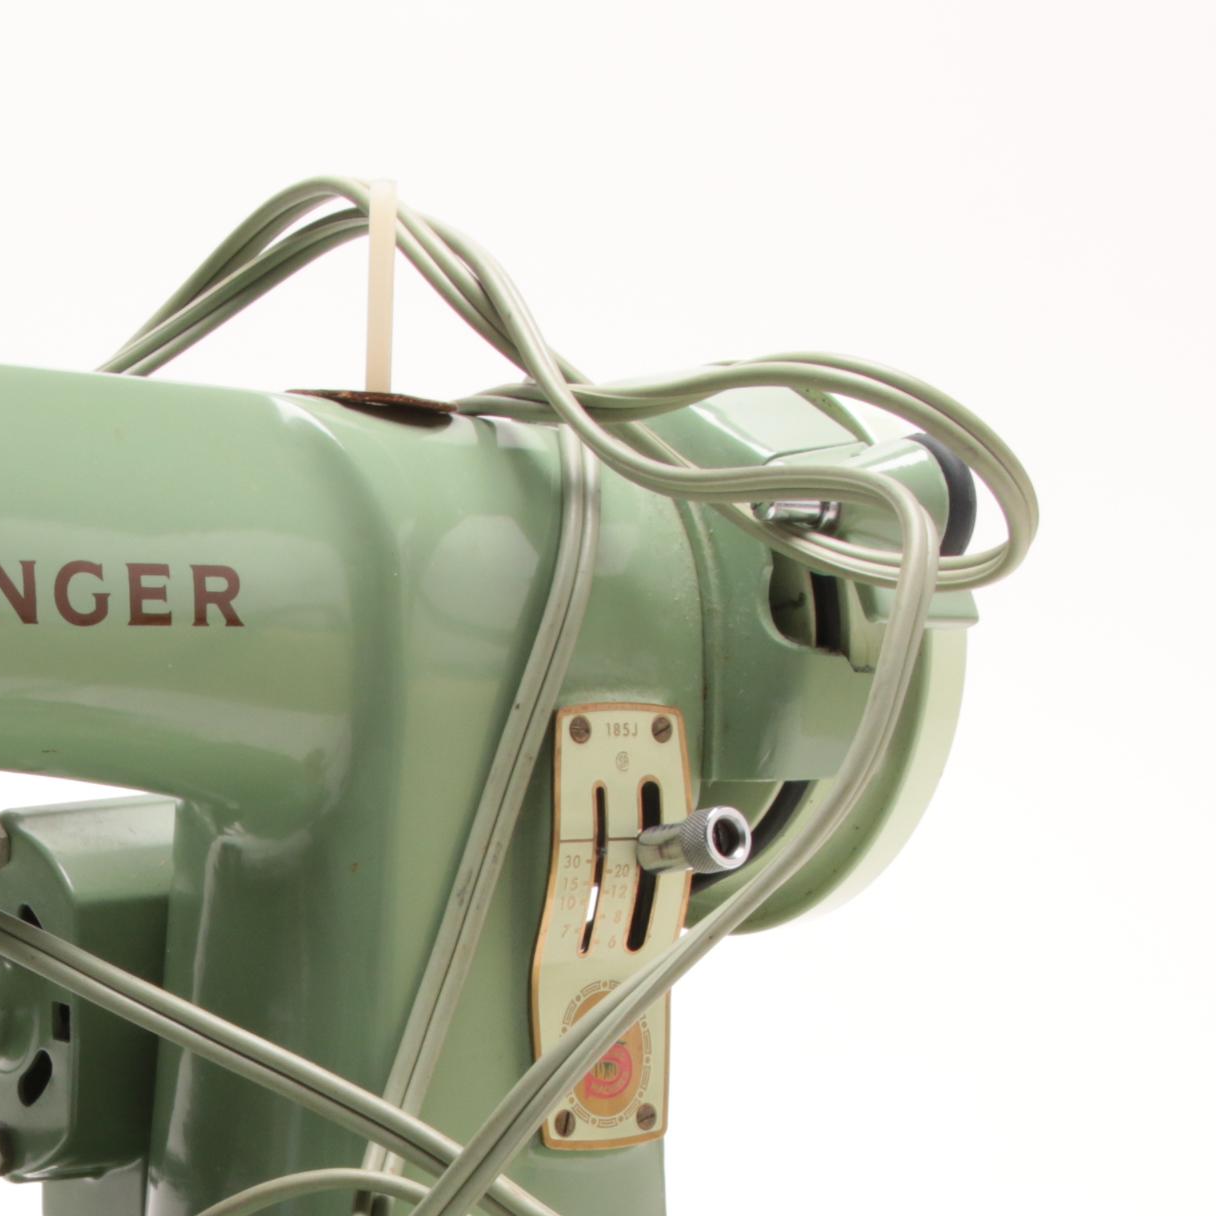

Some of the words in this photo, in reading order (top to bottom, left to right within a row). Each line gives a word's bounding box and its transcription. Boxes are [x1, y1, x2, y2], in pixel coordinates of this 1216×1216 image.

[605, 722, 639, 737] 185J
[564, 855, 581, 869] 30
[614, 864, 630, 878] 20
[563, 877, 579, 891] 15
[610, 885, 627, 898] 12
[560, 896, 577, 911] 10
[560, 924, 572, 939] 7
[607, 935, 617, 949] 6
